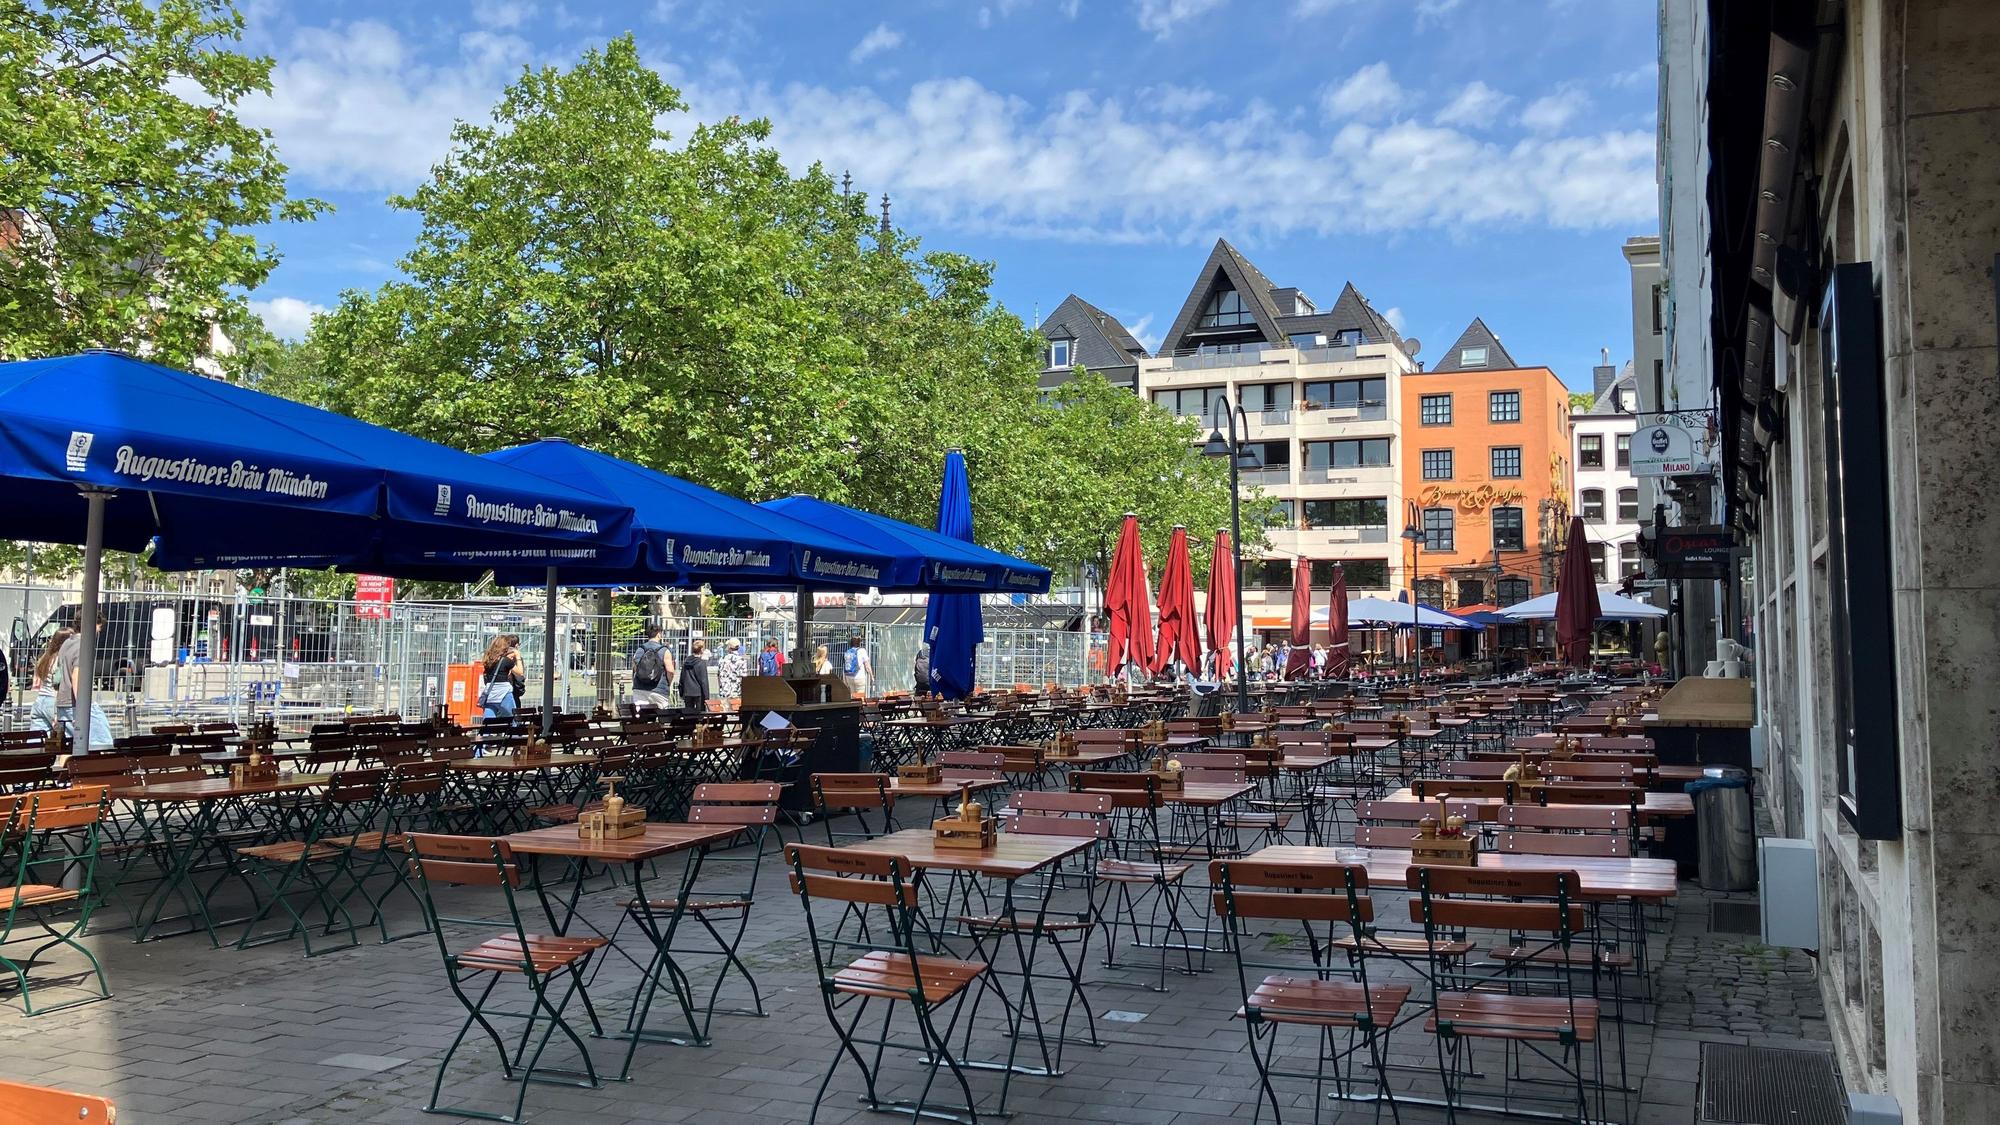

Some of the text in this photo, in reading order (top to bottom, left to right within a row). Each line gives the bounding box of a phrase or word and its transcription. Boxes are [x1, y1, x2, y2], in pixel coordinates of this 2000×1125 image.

[265, 468, 328, 499] München
[557, 509, 599, 534] München
[816, 595, 863, 606] APOSL
